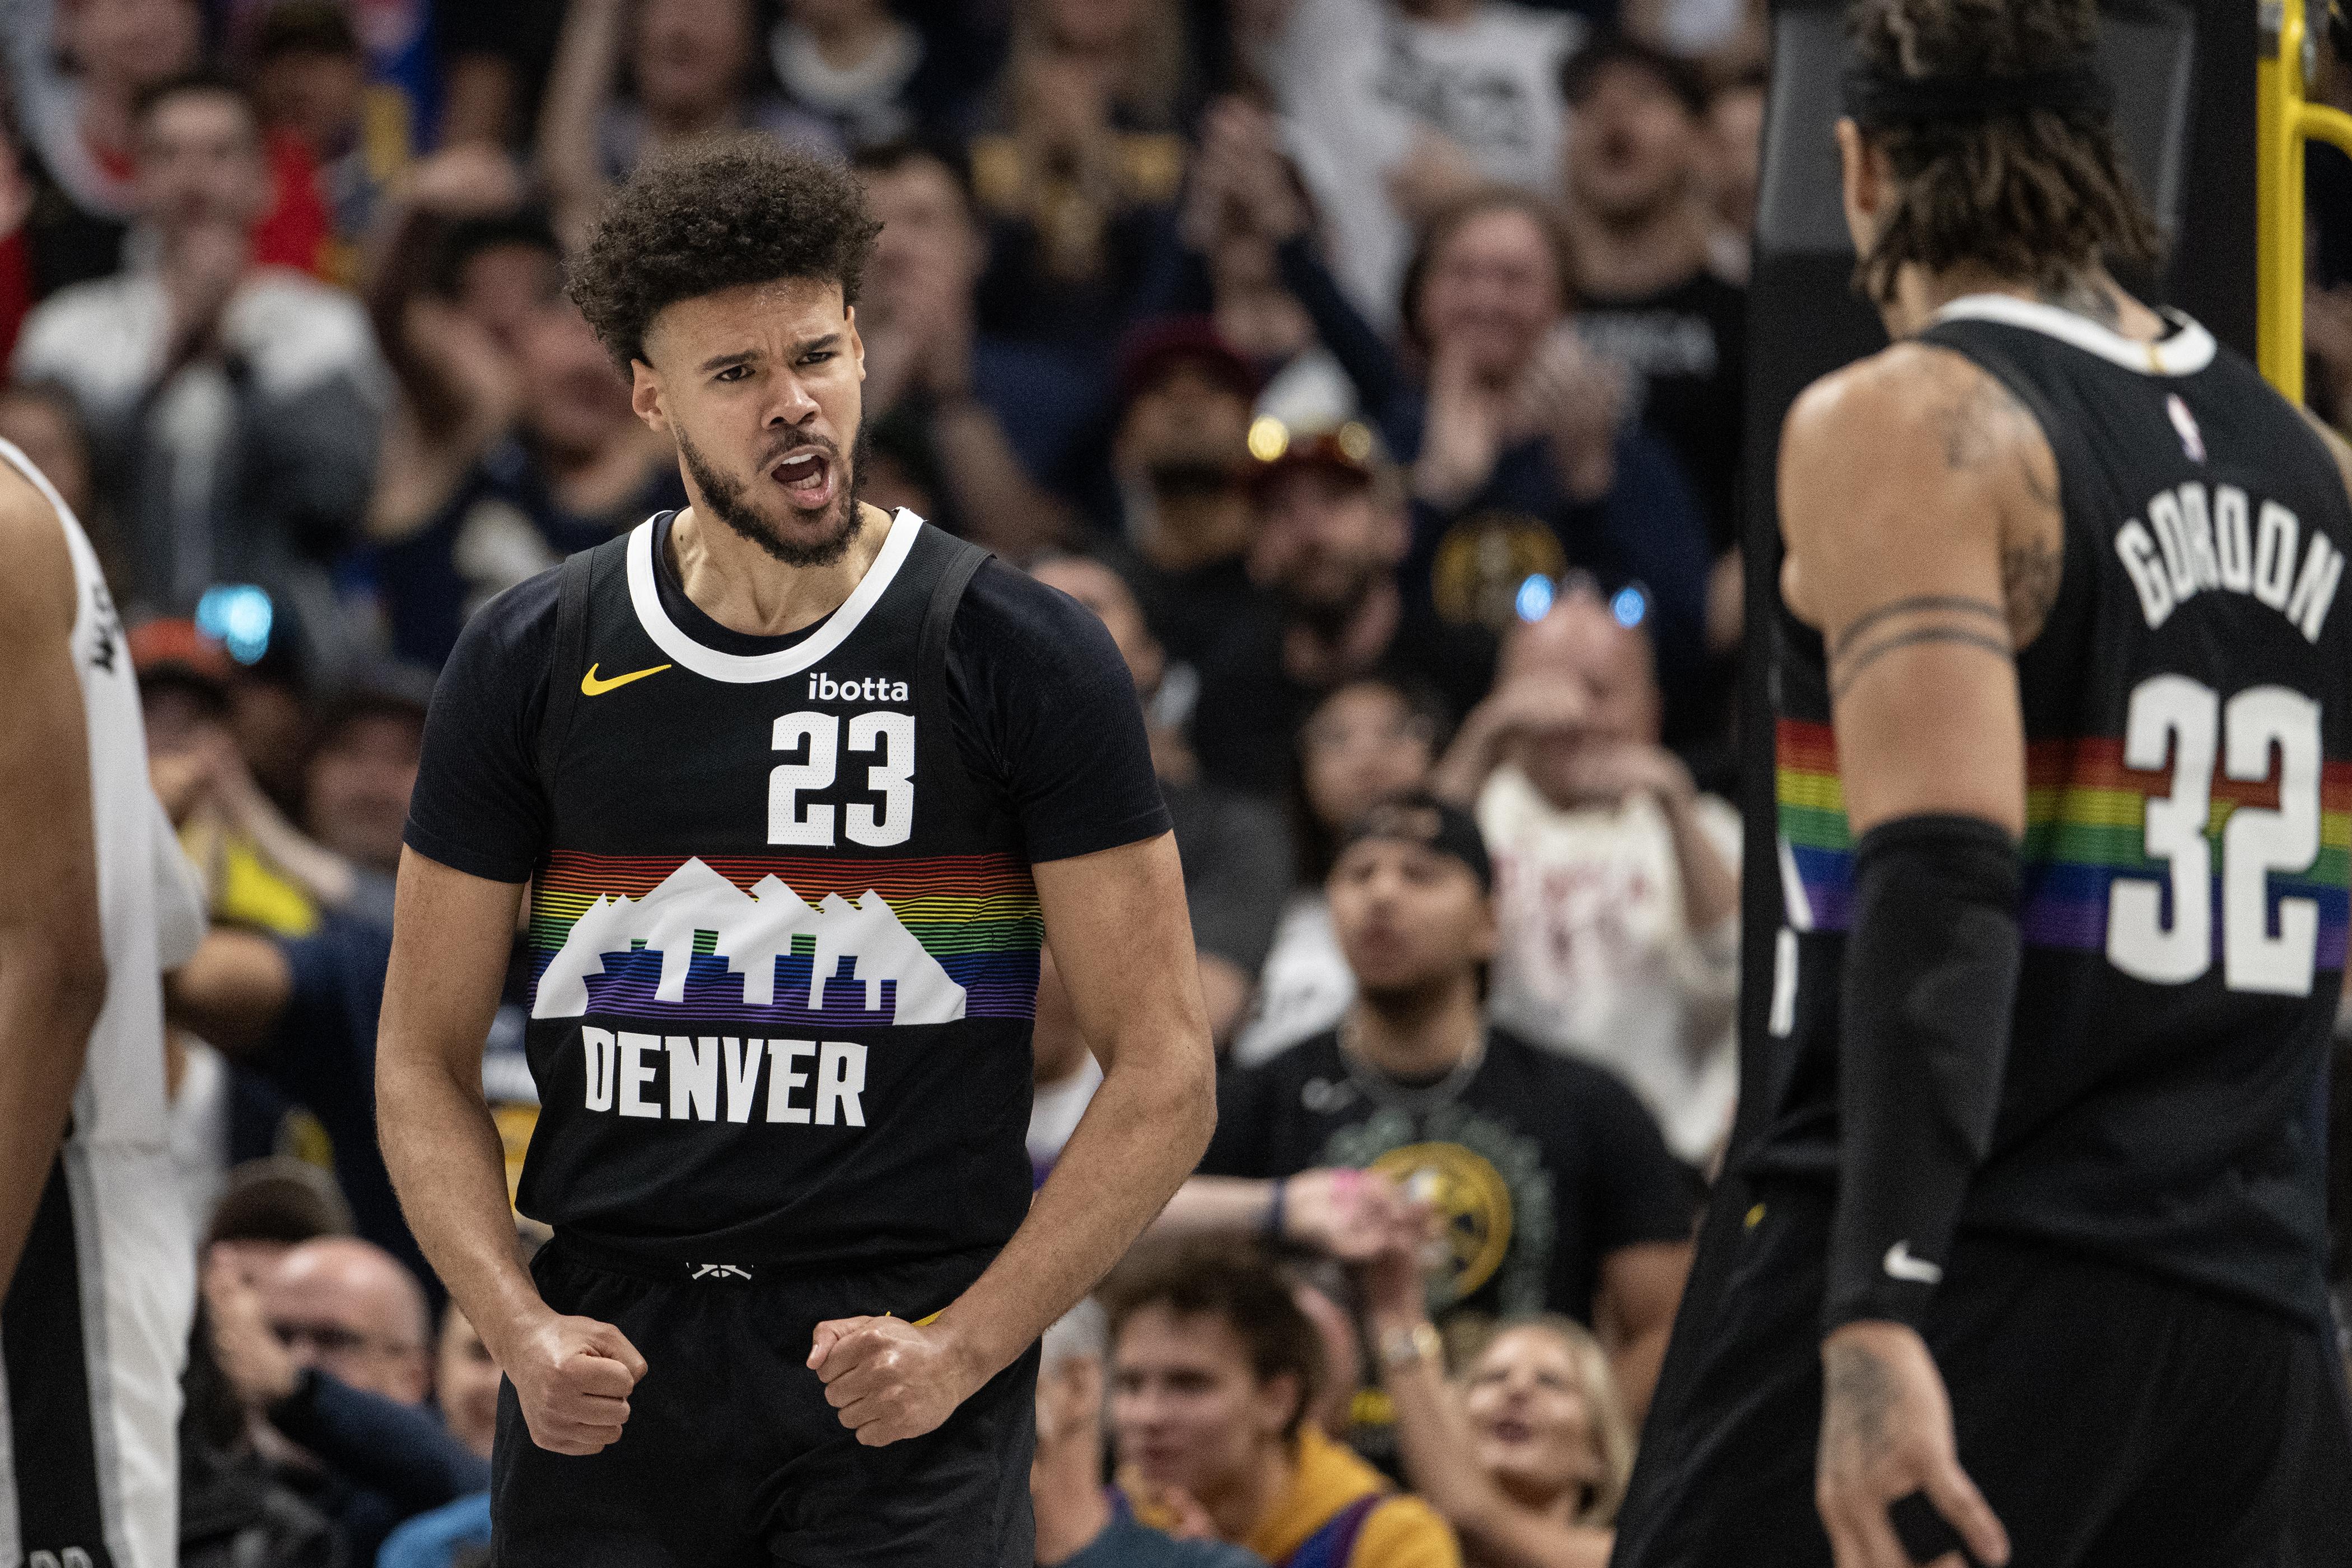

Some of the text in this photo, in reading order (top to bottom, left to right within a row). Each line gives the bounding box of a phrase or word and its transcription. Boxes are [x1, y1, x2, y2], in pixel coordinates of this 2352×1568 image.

[2115, 482, 2345, 643] GORDON
[808, 672, 908, 702] ibotta
[767, 711, 916, 847] 23
[2108, 675, 2322, 996] 32
[581, 1025, 868, 1127] DENVER
